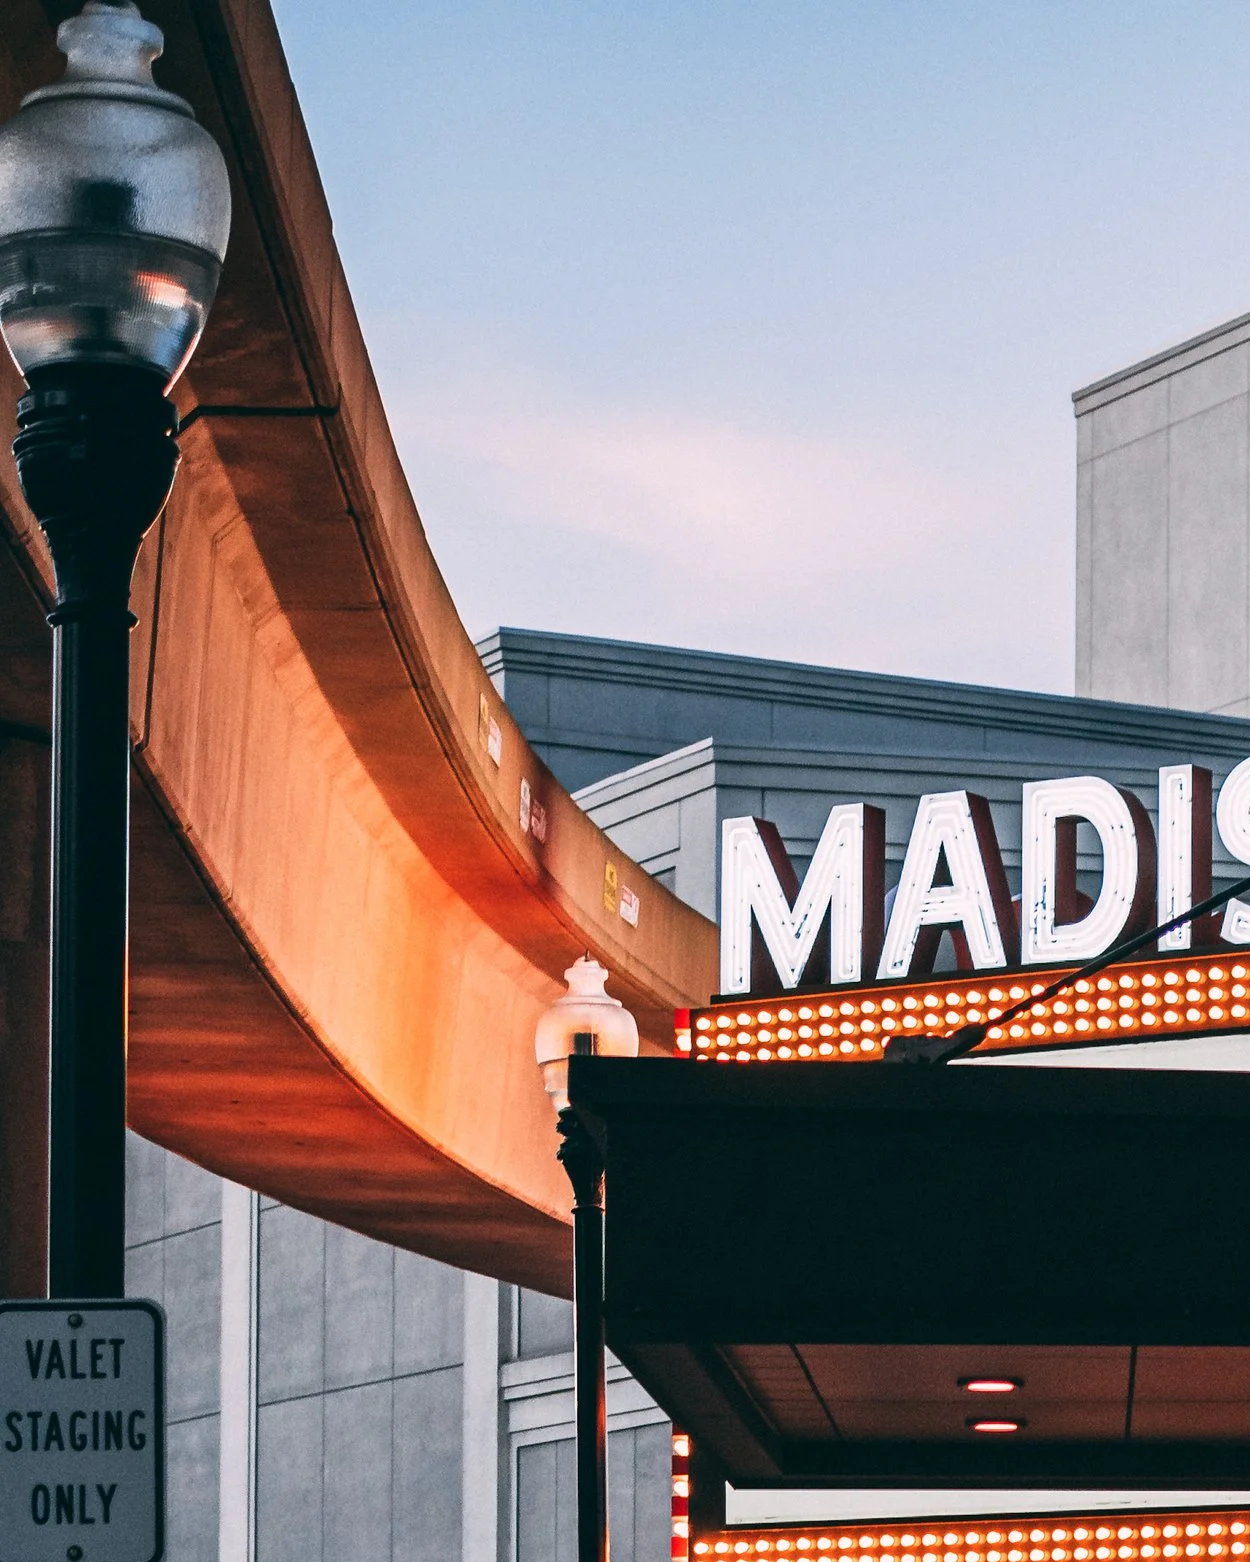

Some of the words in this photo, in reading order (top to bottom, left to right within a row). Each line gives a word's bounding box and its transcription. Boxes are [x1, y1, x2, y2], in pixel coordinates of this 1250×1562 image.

[25, 1338, 126, 1380] VALET
[5, 1410, 147, 1452] STAGING
[31, 1483, 118, 1526] ONLY
